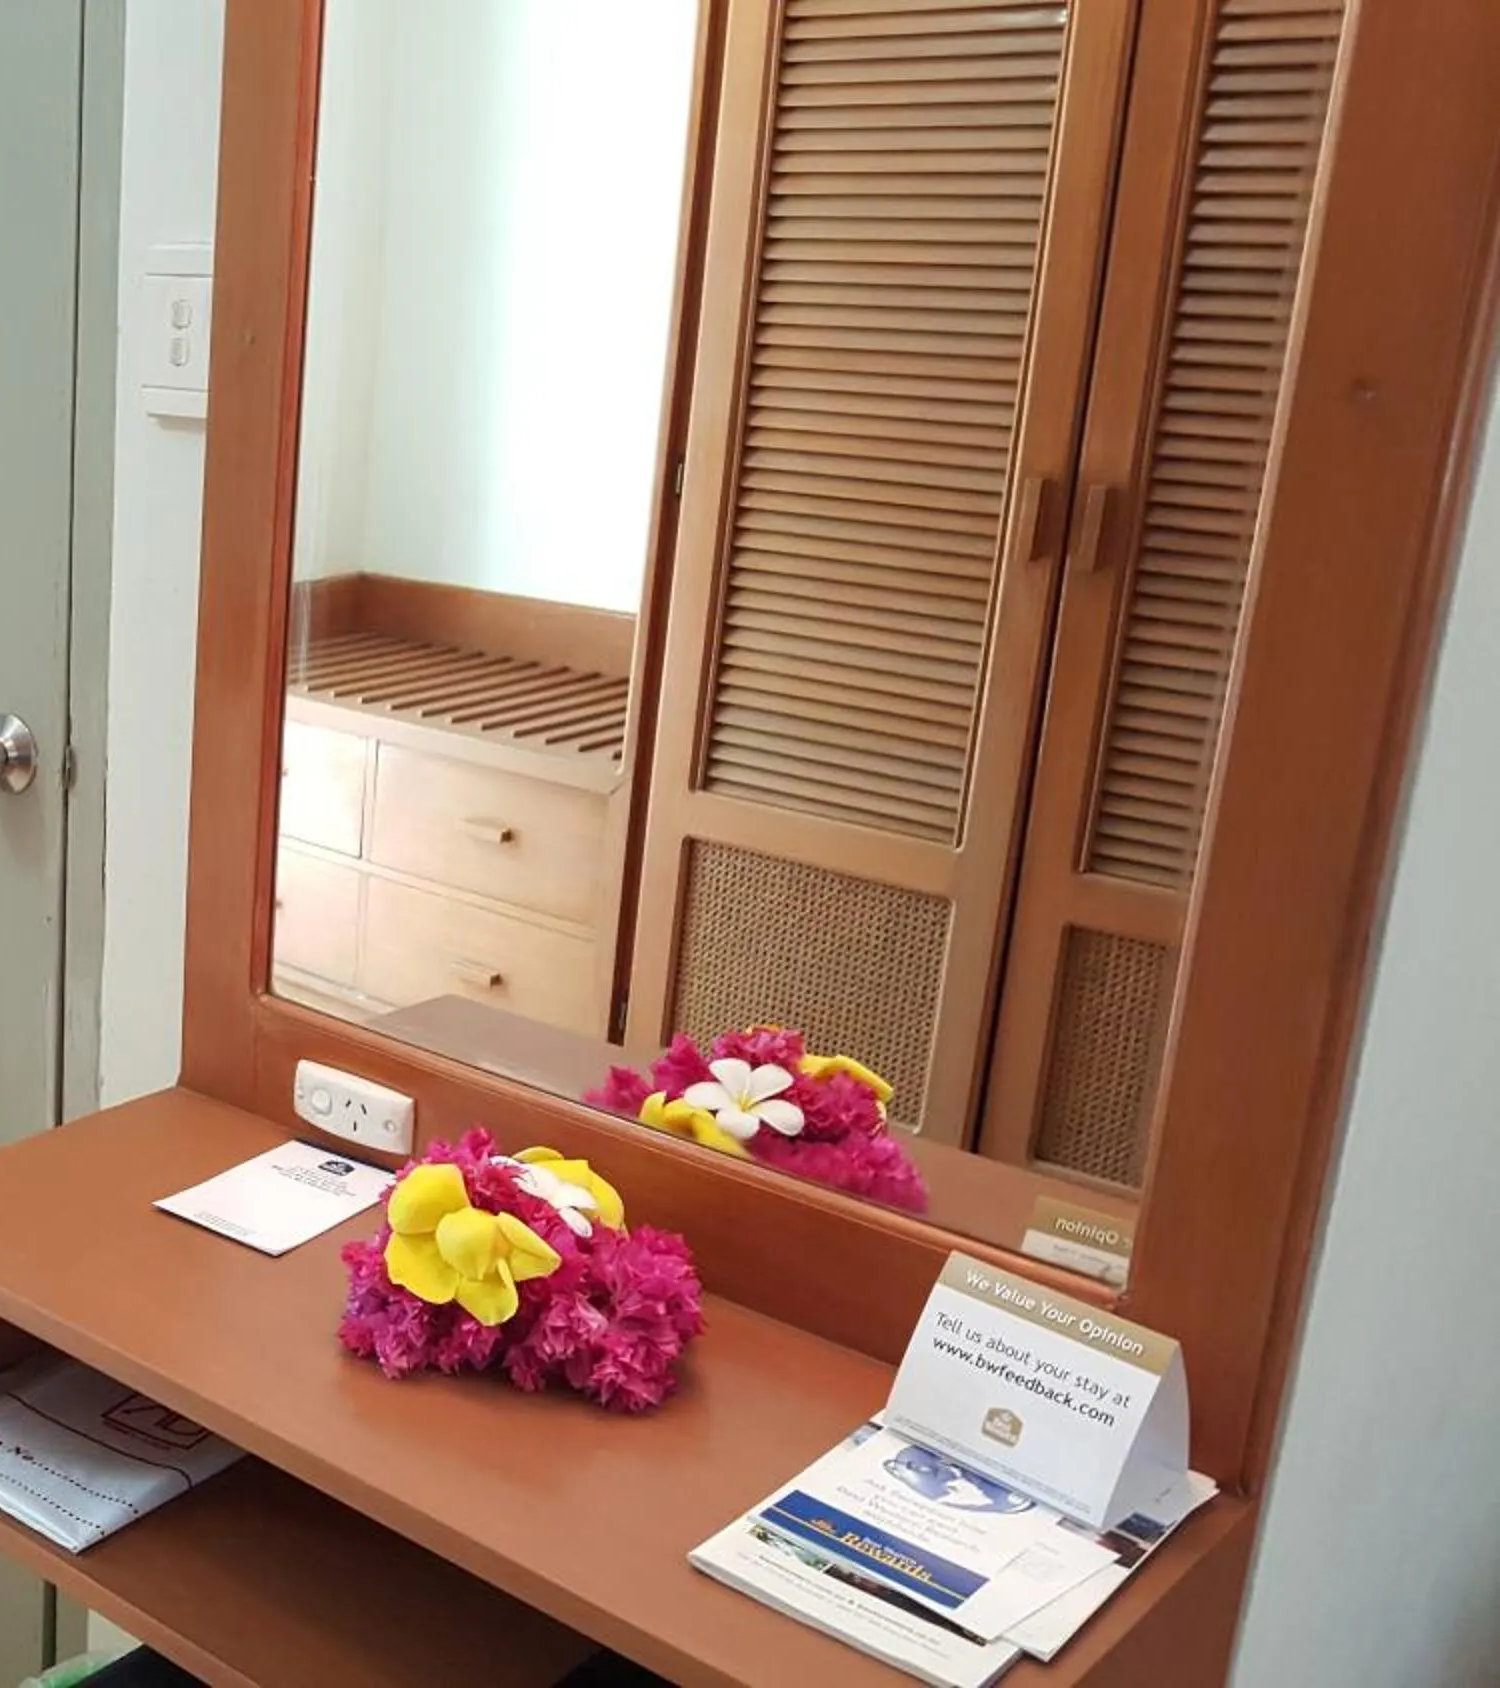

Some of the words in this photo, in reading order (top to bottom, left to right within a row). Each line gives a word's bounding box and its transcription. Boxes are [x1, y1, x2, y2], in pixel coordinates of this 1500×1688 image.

[965, 1268, 990, 1291] We
[994, 1281, 1038, 1312] Value
[1039, 1300, 1078, 1328] Your
[1079, 1318, 1145, 1357] Opinion
[932, 1336, 1117, 1429] www.bwfeedback.com
[935, 1311, 964, 1336] Tell
[965, 1326, 983, 1344] us
[985, 1334, 1032, 1366] about
[1034, 1358, 1073, 1382] your
[1074, 1374, 1111, 1401] stay
[1112, 1391, 1132, 1410] at
